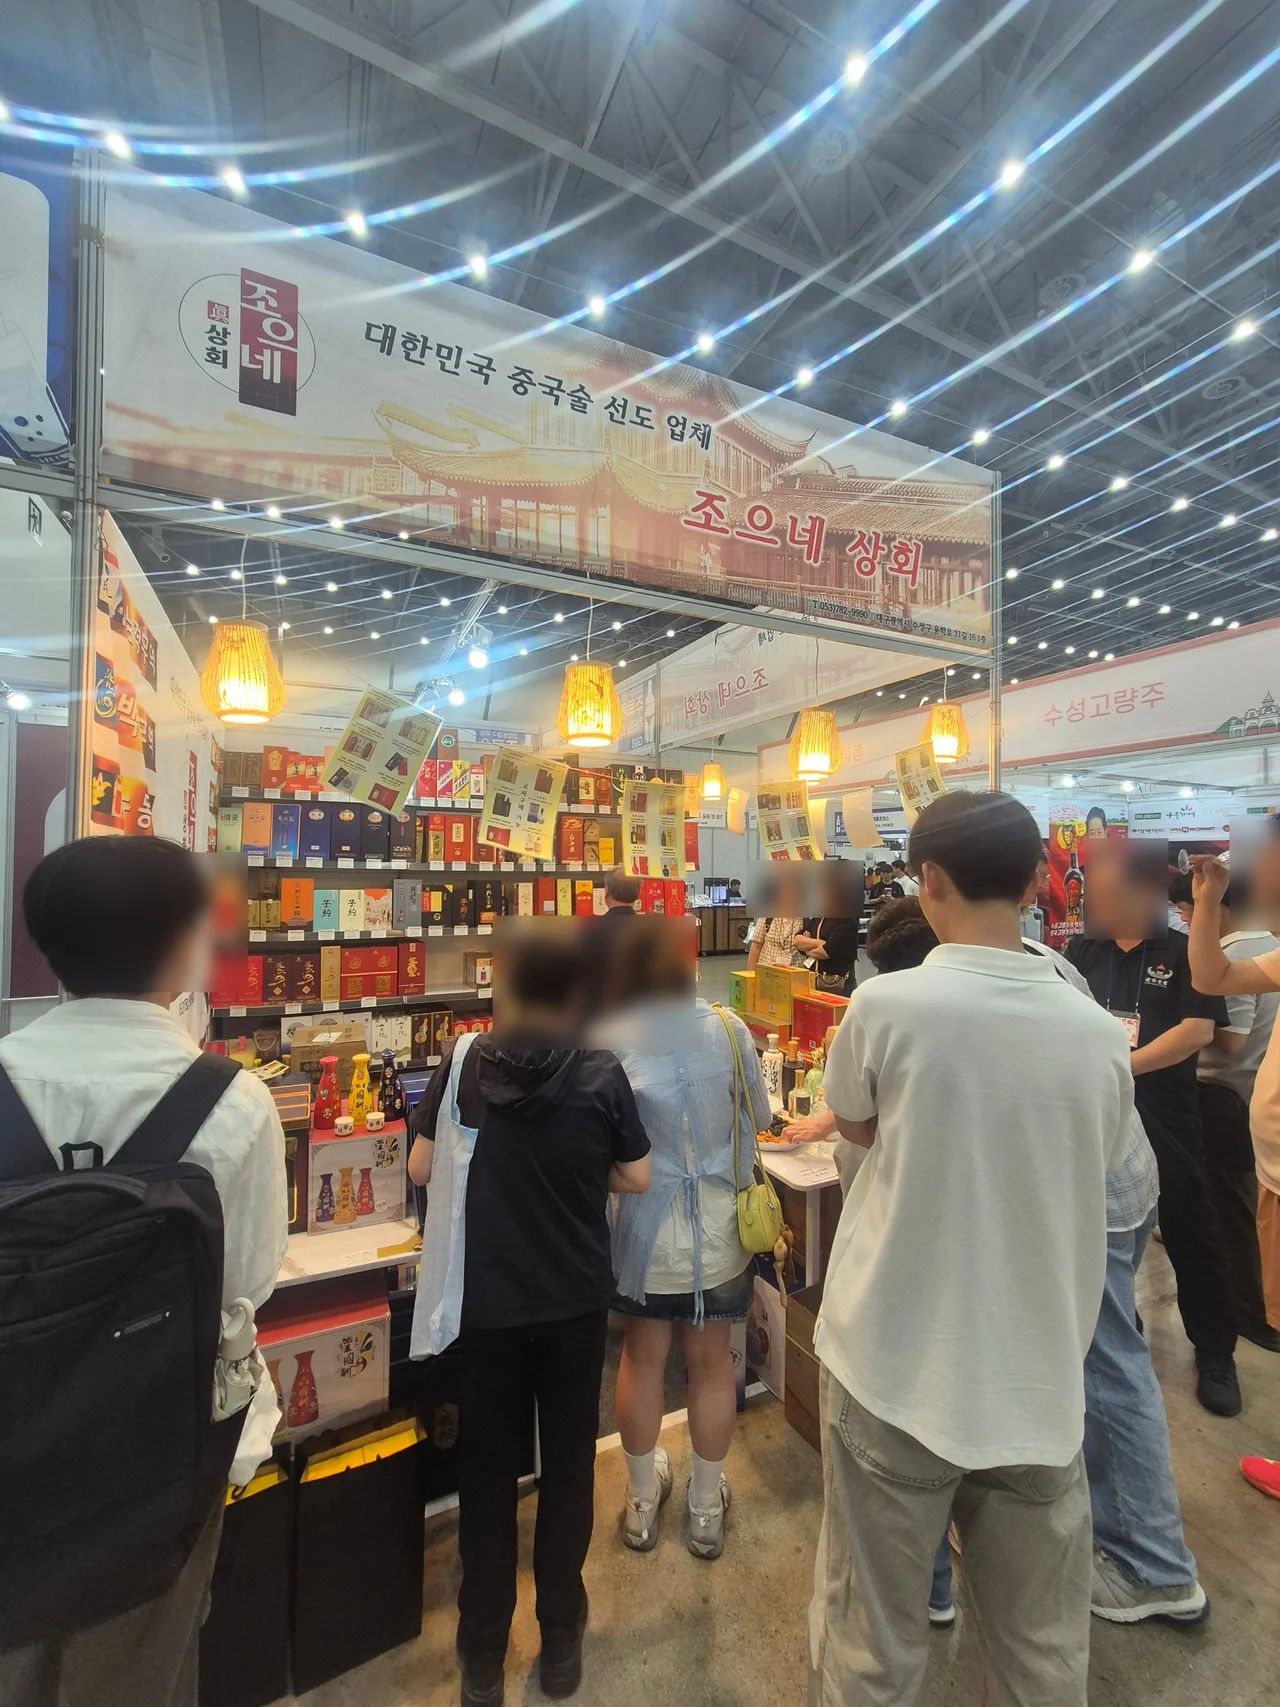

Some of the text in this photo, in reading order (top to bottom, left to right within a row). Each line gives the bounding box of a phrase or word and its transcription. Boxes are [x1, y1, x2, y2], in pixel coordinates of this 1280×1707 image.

[204, 324, 231, 369] 상회
[240, 279, 298, 384] 조으네
[364, 321, 713, 451] 대한민국 중국술 선도 업체
[683, 490, 923, 587] 조으네 상회
[812, 600, 868, 619] T.053)782-9990
[876, 613, 911, 629] 대구광역시
[912, 620, 932, 633] 수성구
[1043, 681, 1165, 727] 수성고량주
